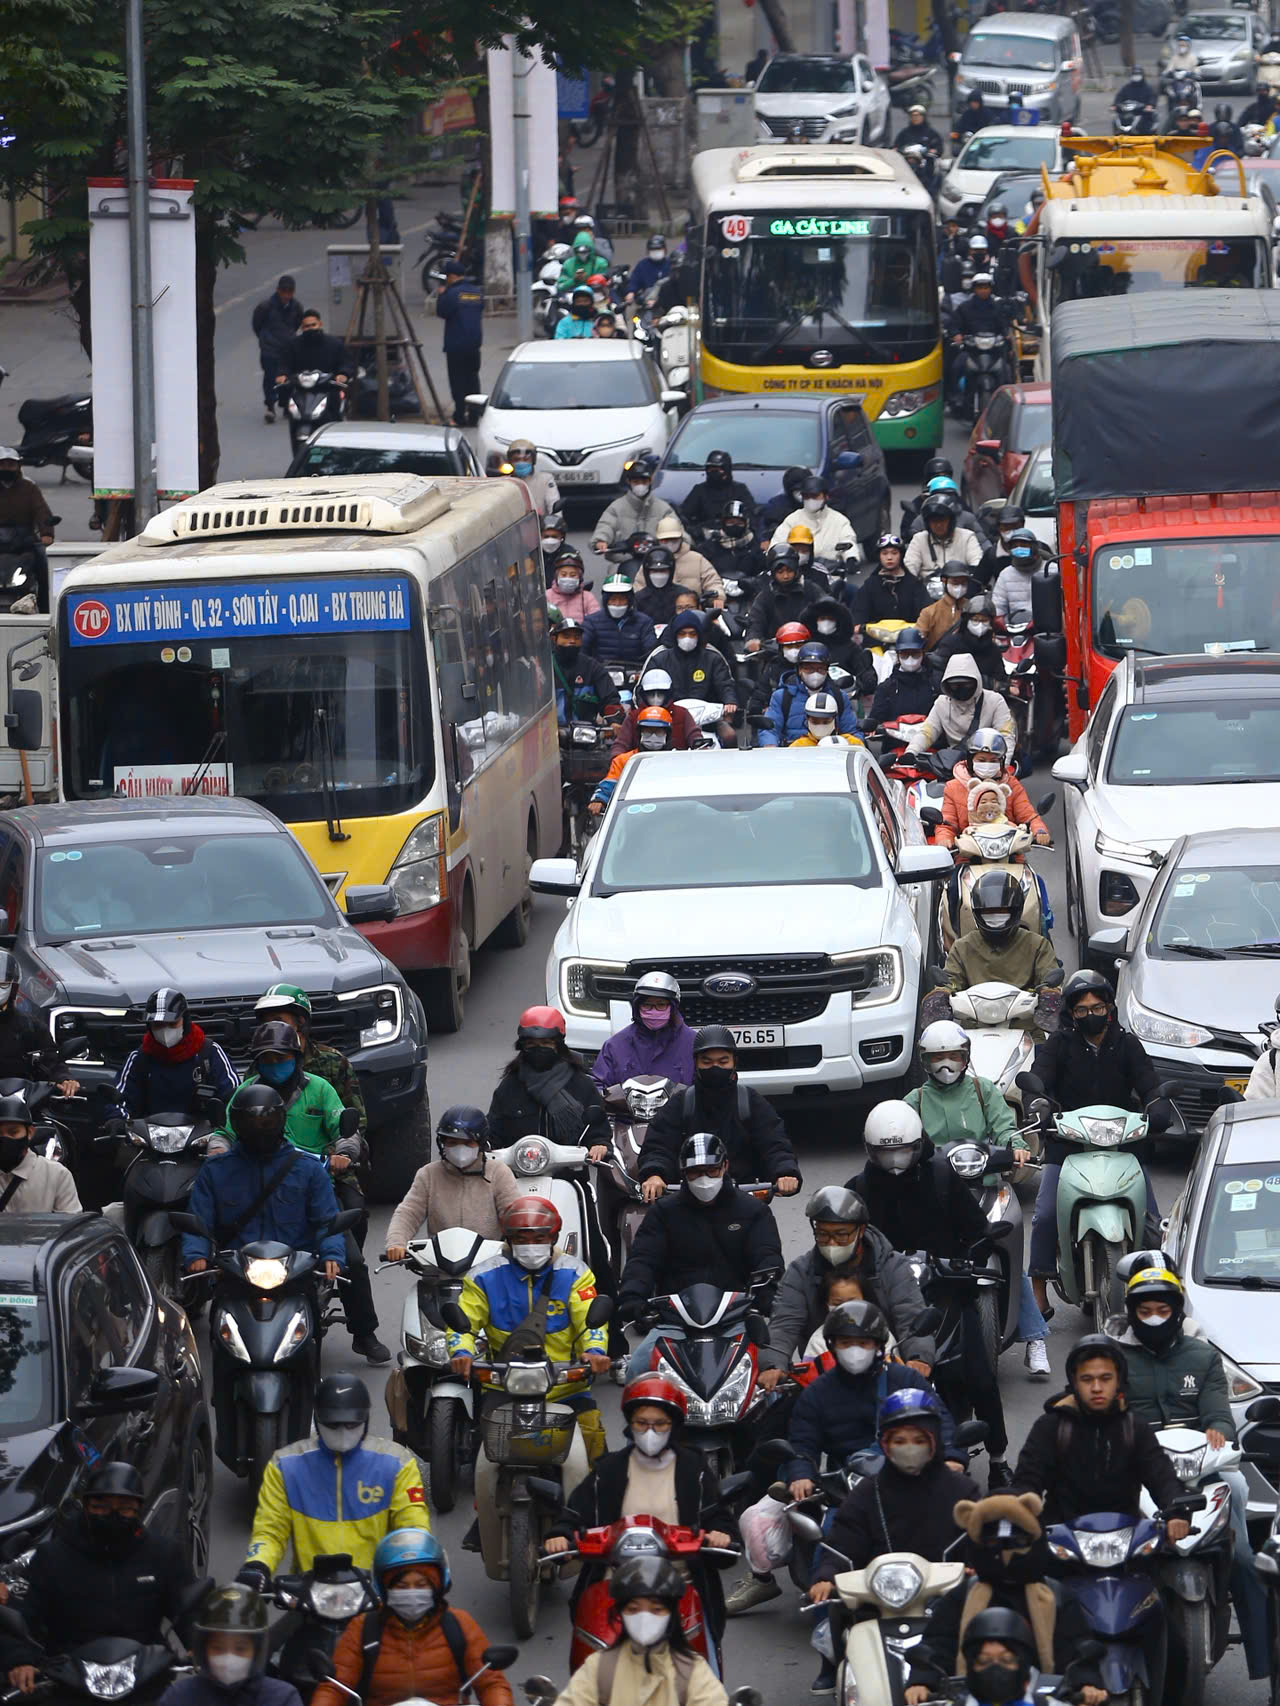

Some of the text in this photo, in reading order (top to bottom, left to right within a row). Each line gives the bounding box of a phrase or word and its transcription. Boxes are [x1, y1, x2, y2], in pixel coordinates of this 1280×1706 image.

[727, 219, 746, 237] 49
[770, 217, 870, 235] GA CÁT LINH
[115, 603, 132, 633] BX
[134, 596, 152, 632] MỸ
[153, 594, 182, 631] ĐÌNH
[191, 598, 206, 632] QL
[207, 598, 223, 628] 32
[232, 593, 256, 626] SƠN
[258, 589, 279, 625] TÂY
[288, 592, 319, 627] Q.OAI
[331, 591, 348, 622] BX
[349, 590, 387, 621] TRUNG
[388, 583, 405, 620] HÀ
[357, 1479, 385, 1504] be
